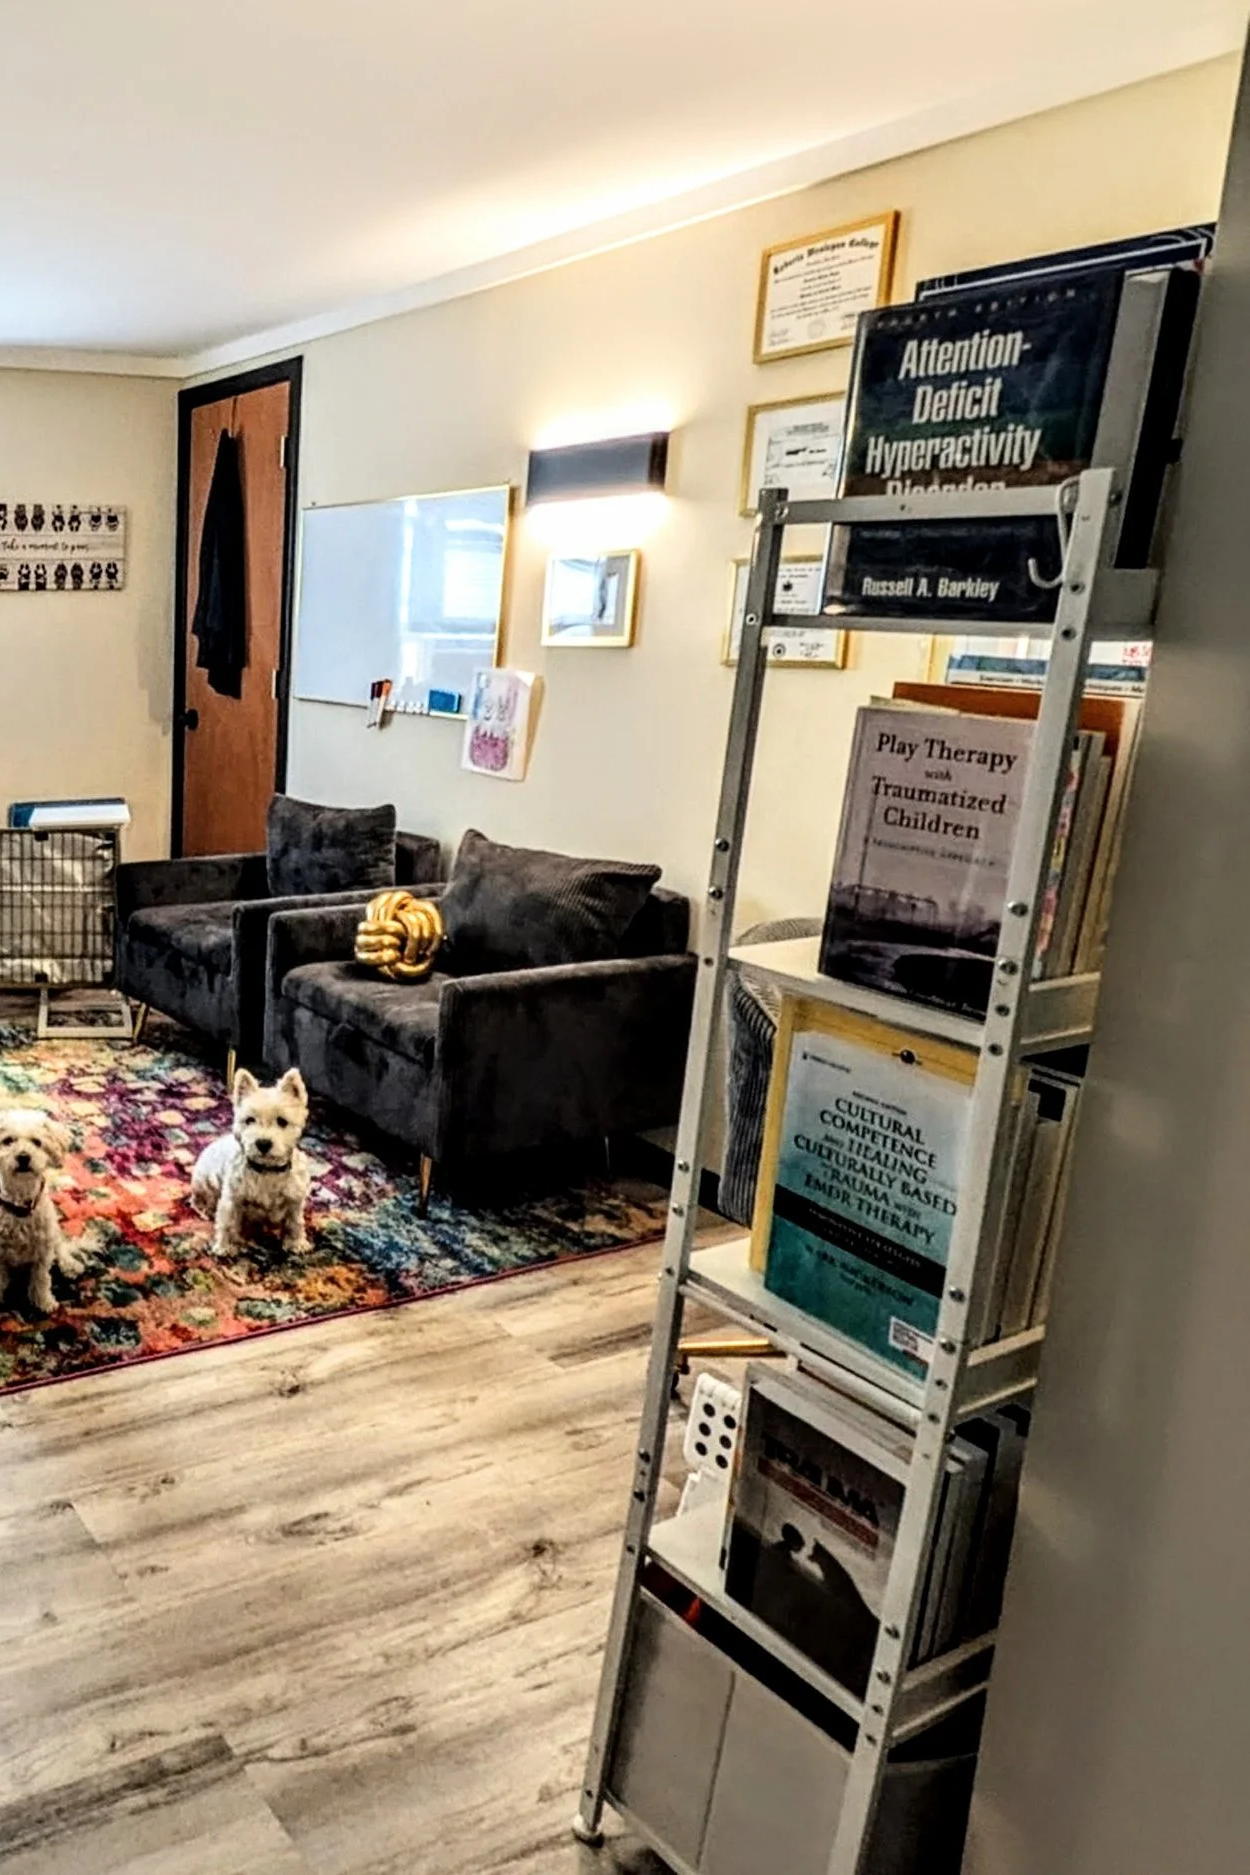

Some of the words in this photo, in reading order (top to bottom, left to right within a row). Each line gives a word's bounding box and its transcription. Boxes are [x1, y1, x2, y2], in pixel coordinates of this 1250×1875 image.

[898, 328, 1032, 380] Attention-
[912, 376, 1002, 424] Deficit
[865, 423, 1042, 478] Hyperactivity
[862, 576, 914, 598] Russell
[916, 578, 932, 597] A.
[937, 578, 1000, 602] Barkley
[877, 731, 919, 762] Play
[924, 738, 1018, 774] Therapy
[924, 768, 952, 781] with
[872, 775, 1007, 815] Traumatized
[884, 806, 980, 840] Children
[819, 1109, 937, 1169] COMPETENCE
[835, 1098, 925, 1145] CULTURAL
[793, 1134, 897, 1190] CULTURALLY
[901, 1181, 958, 1216] BASED
[820, 1162, 890, 1207] TRAUMA
[849, 1139, 928, 1184] HEALING
[805, 1174, 851, 1206] EMDR
[857, 1198, 935, 1245] THERAPY
